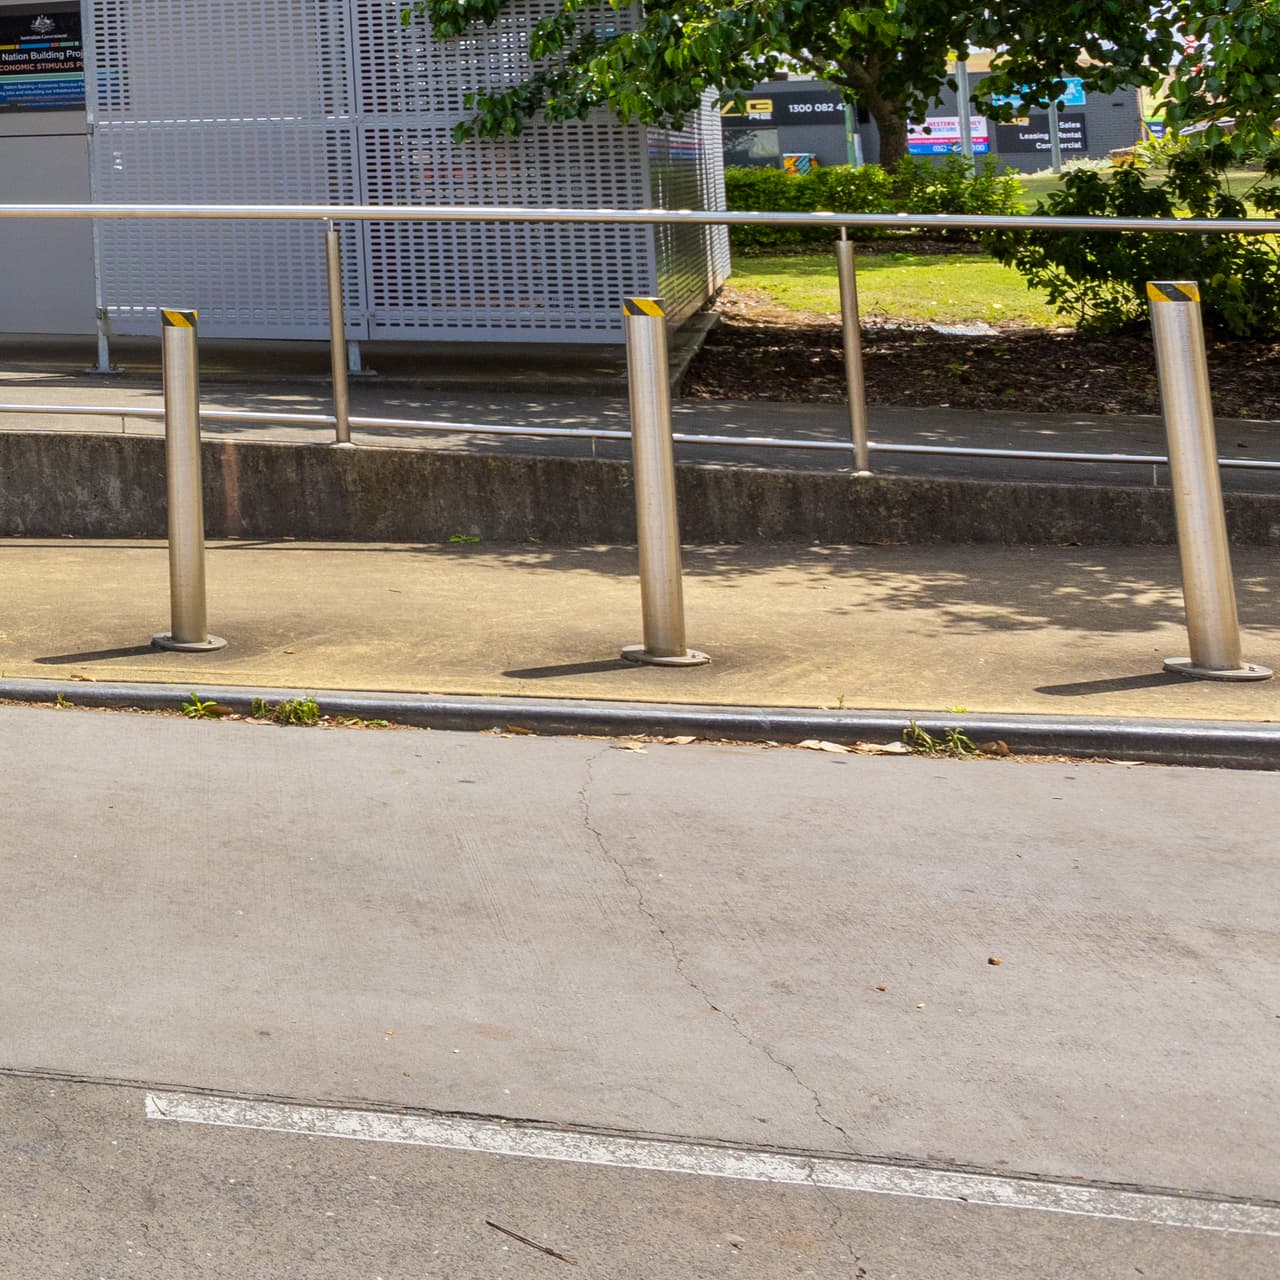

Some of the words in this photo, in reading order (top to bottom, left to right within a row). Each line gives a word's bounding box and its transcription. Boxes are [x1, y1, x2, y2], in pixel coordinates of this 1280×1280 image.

[2, 53, 28, 61] Nation
[31, 51, 64, 60] Building
[37, 62, 75, 70] STIMULUS
[788, 103, 812, 113] 1300
[814, 102, 834, 112] 082
[1059, 121, 1081, 129] Sales
[1019, 132, 1049, 140] Leasing
[1035, 141, 1082, 149] Comercial
